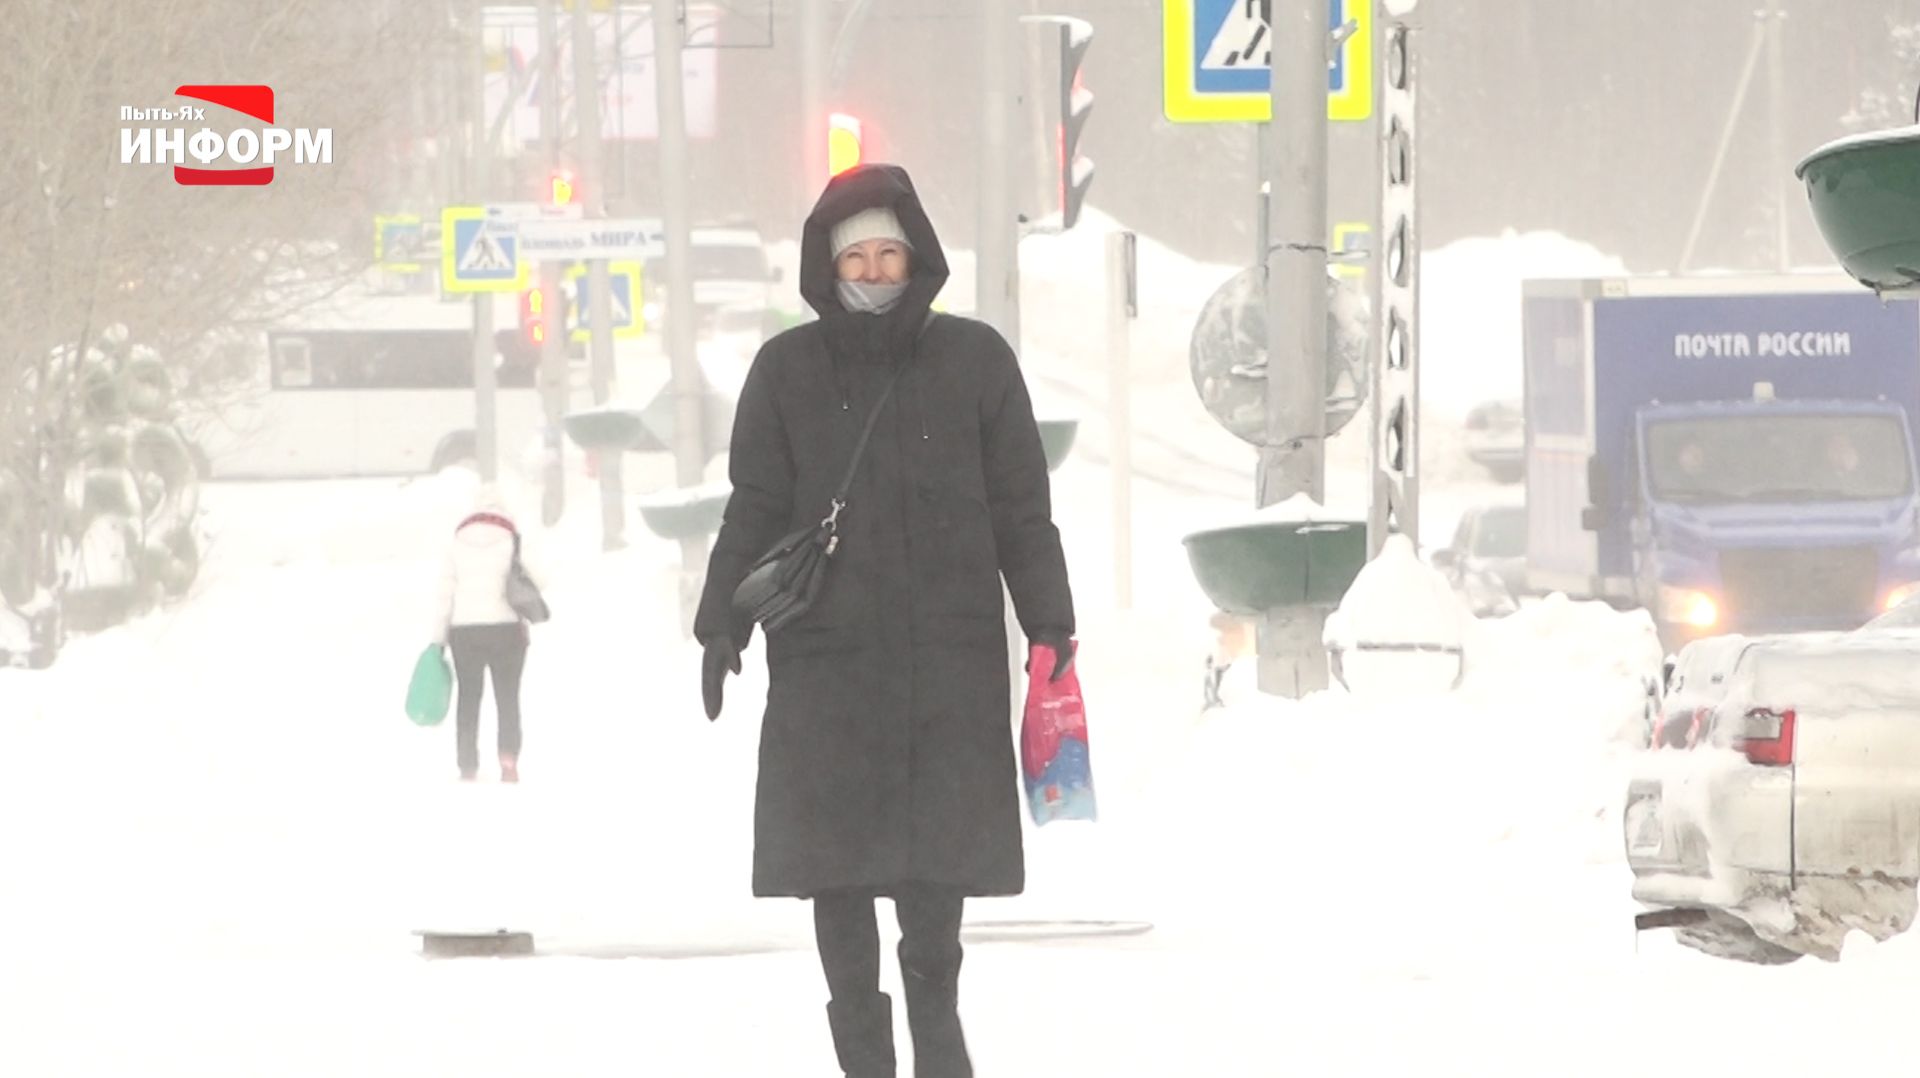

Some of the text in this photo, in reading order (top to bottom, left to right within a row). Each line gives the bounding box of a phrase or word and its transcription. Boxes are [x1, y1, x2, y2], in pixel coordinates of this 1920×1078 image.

[590, 231, 647, 247] МИРА
[1674, 331, 1851, 358] ПОЧТА РОССИИ
